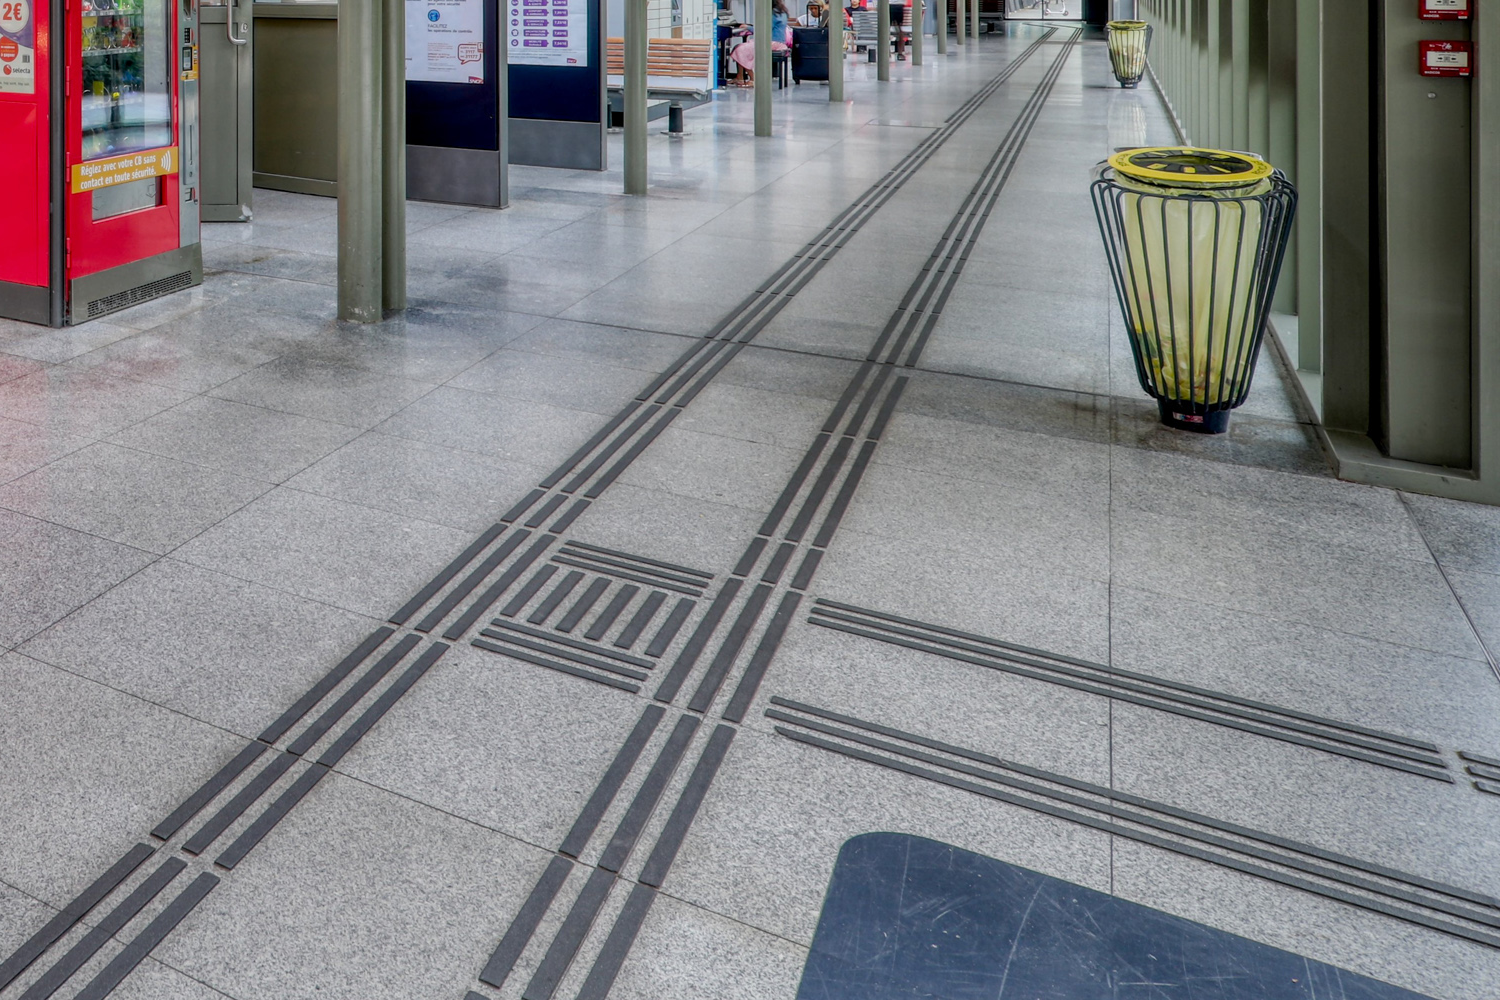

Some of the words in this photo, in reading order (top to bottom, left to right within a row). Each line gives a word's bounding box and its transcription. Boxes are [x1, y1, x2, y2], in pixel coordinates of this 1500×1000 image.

[2, 1, 22, 22] 2€
[80, 165, 102, 177] Réglez
[103, 162, 116, 172] avec
[118, 159, 133, 169] votre
[134, 156, 142, 166] CB
[143, 155, 156, 165] sans
[80, 177, 104, 189] contact
[105, 176, 113, 184] en
[114, 173, 130, 182] toute
[131, 165, 157, 179] sécurité.
